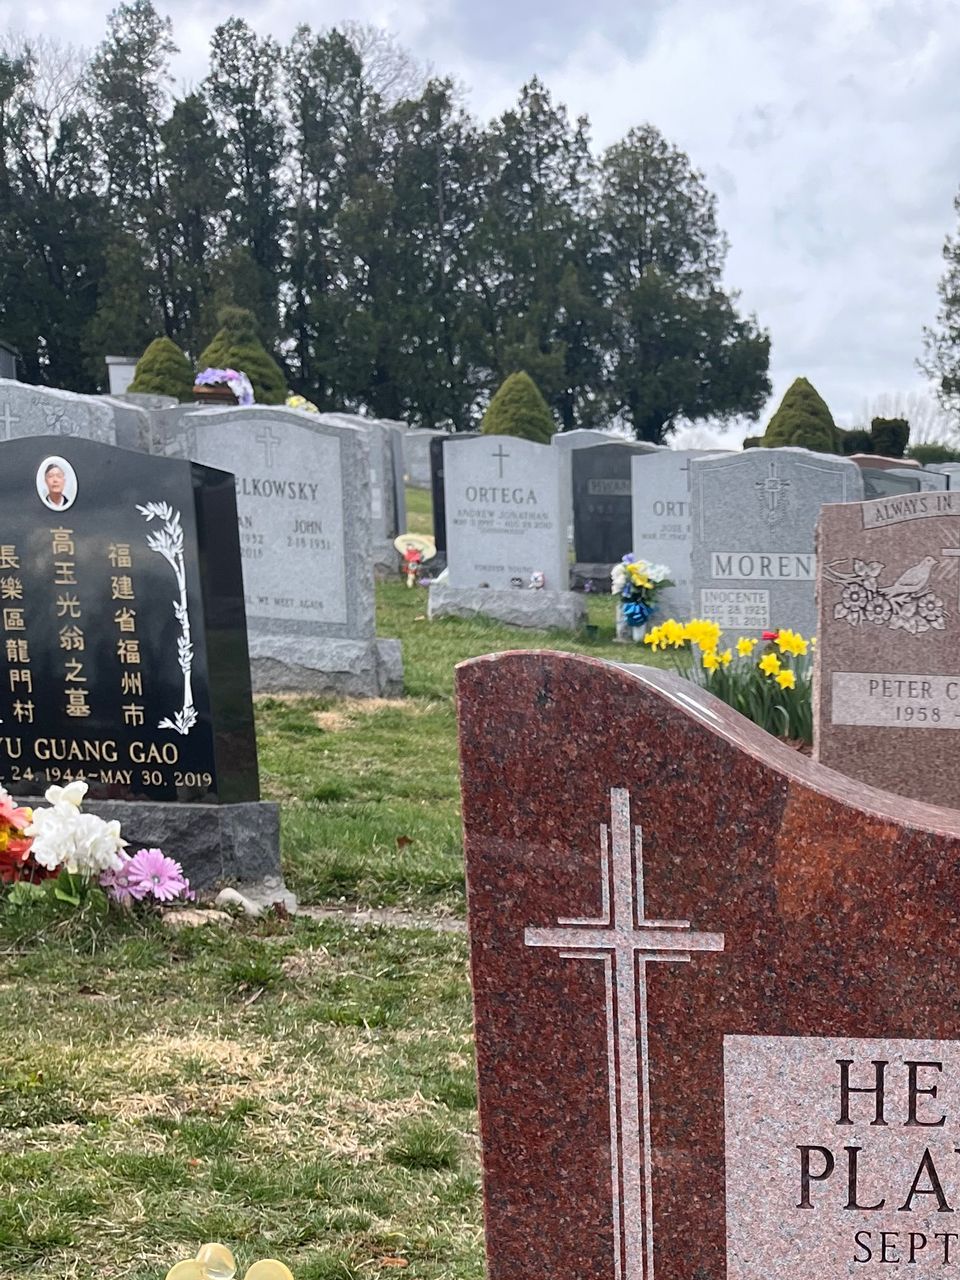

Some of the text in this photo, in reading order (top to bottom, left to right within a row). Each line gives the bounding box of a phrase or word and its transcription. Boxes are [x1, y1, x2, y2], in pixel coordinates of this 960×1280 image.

[465, 486, 538, 505] ORTEGA
[875, 498, 928, 522] ALWAYS
[937, 495, 952, 511] IN
[292, 519, 323, 535] JOHN
[704, 591, 767, 603] INOCENTE
[50, 526, 91, 717] 高玉光翁之墓
[0, 544, 35, 724] 長樂區龍門村
[108, 543, 144, 727] 福建省福州市
[868, 679, 933, 700] PETER
[895, 706, 942, 722] 1958
[34, 738, 118, 763] GUANG
[129, 741, 179, 765] GAO
[173, 772, 212, 787] 2019
